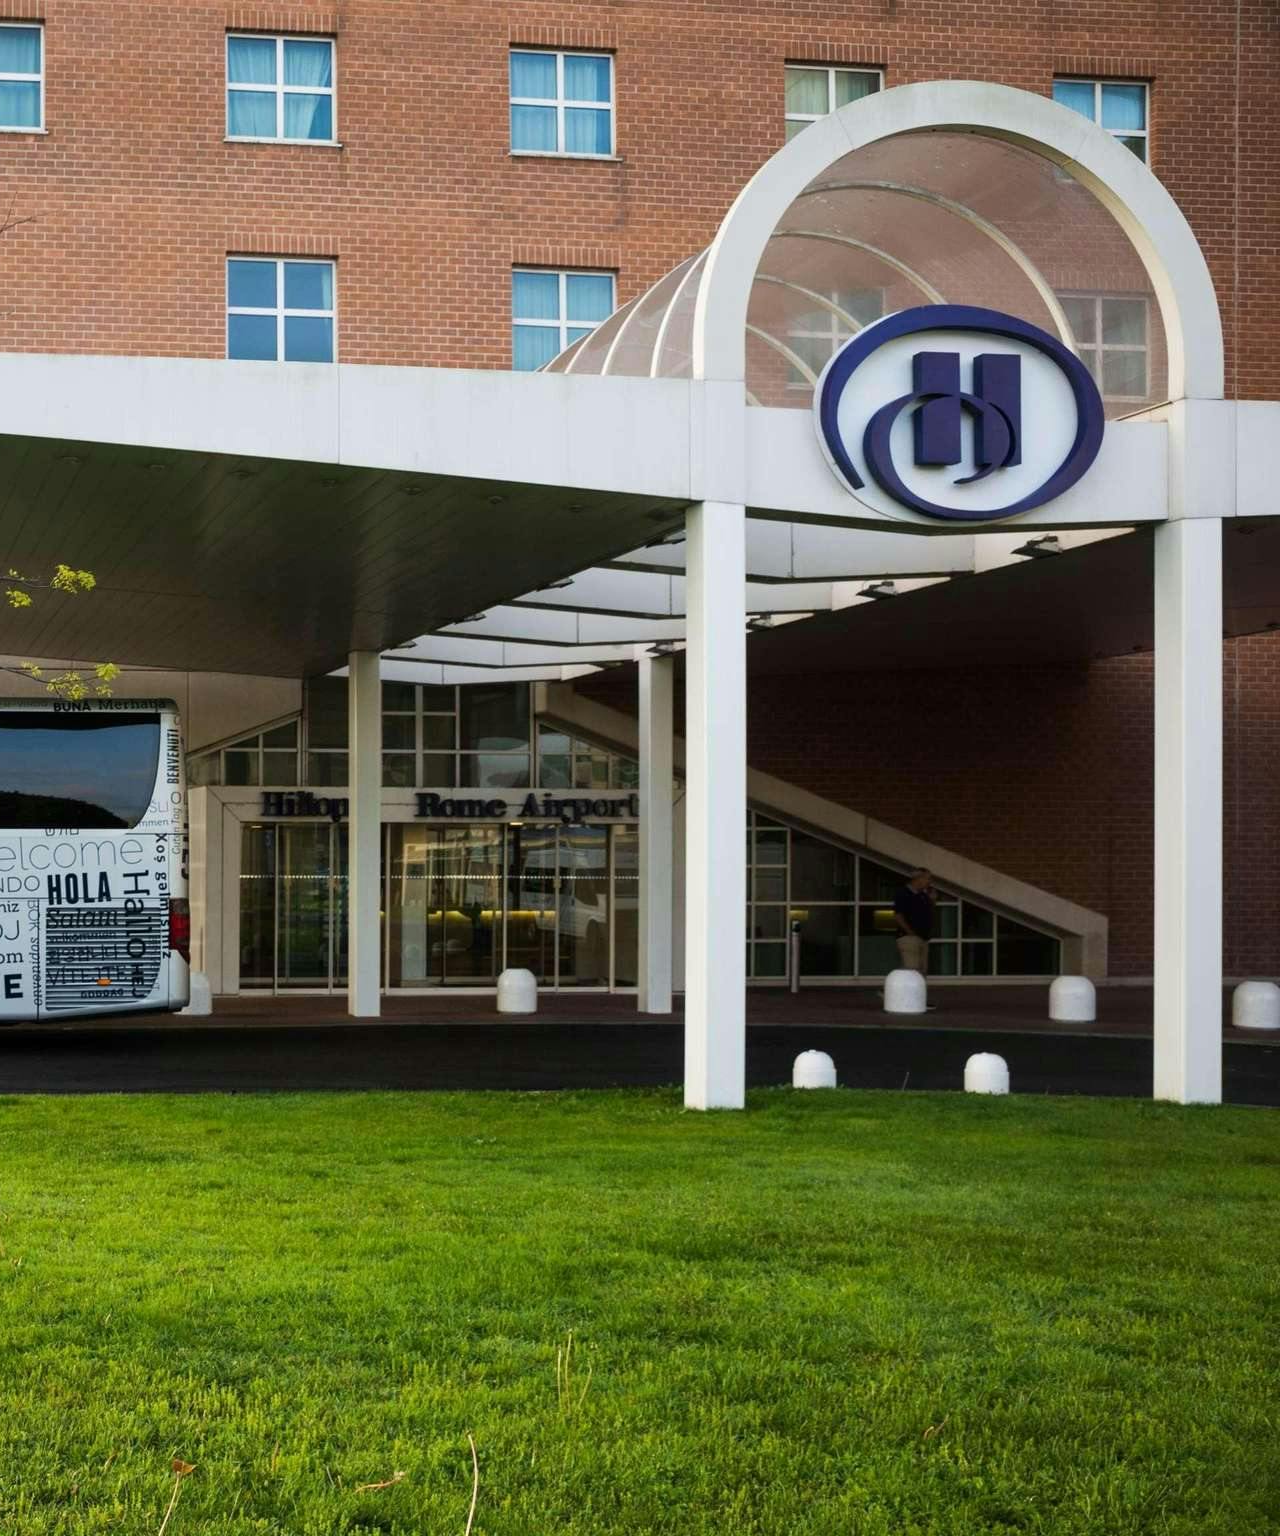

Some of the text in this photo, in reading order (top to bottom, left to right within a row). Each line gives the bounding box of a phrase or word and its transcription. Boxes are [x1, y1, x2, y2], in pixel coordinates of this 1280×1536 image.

[166, 729, 180, 784] BENVENUTI
[415, 792, 506, 818] Rome
[47, 871, 112, 906] HOLA
[123, 869, 152, 958] Hallo
